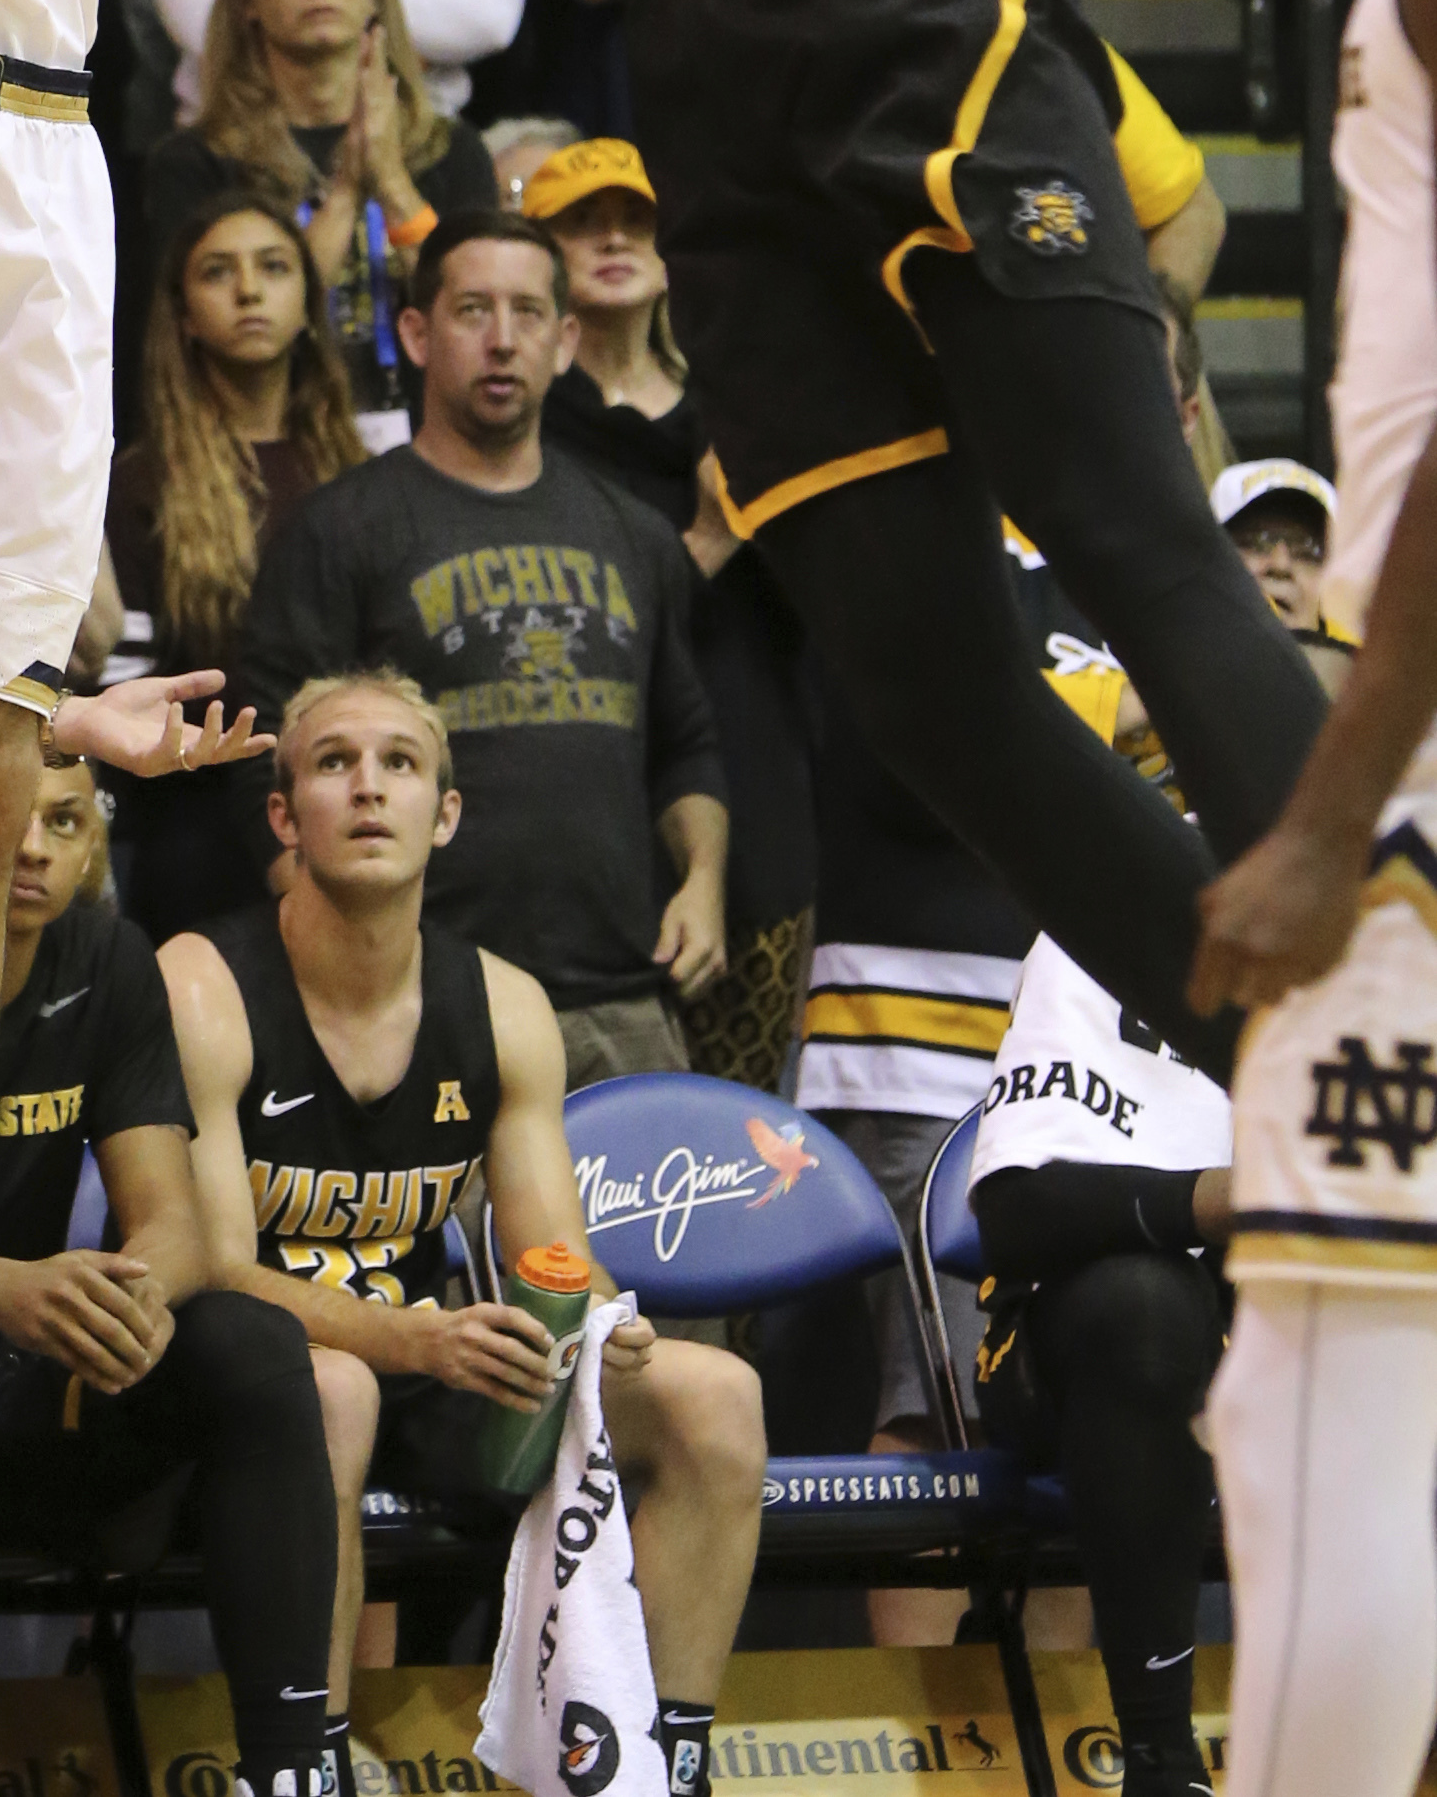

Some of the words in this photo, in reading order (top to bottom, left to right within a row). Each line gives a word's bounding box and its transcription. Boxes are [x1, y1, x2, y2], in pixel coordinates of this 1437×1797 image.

[410, 544, 639, 639] WICHITA
[443, 606, 632, 656] STATE
[437, 677, 638, 732] SHOCKERS
[433, 1080, 471, 1123] A
[652, 1146, 767, 1262] Jim
[788, 1473, 980, 1503] SPECSEATS.COM
